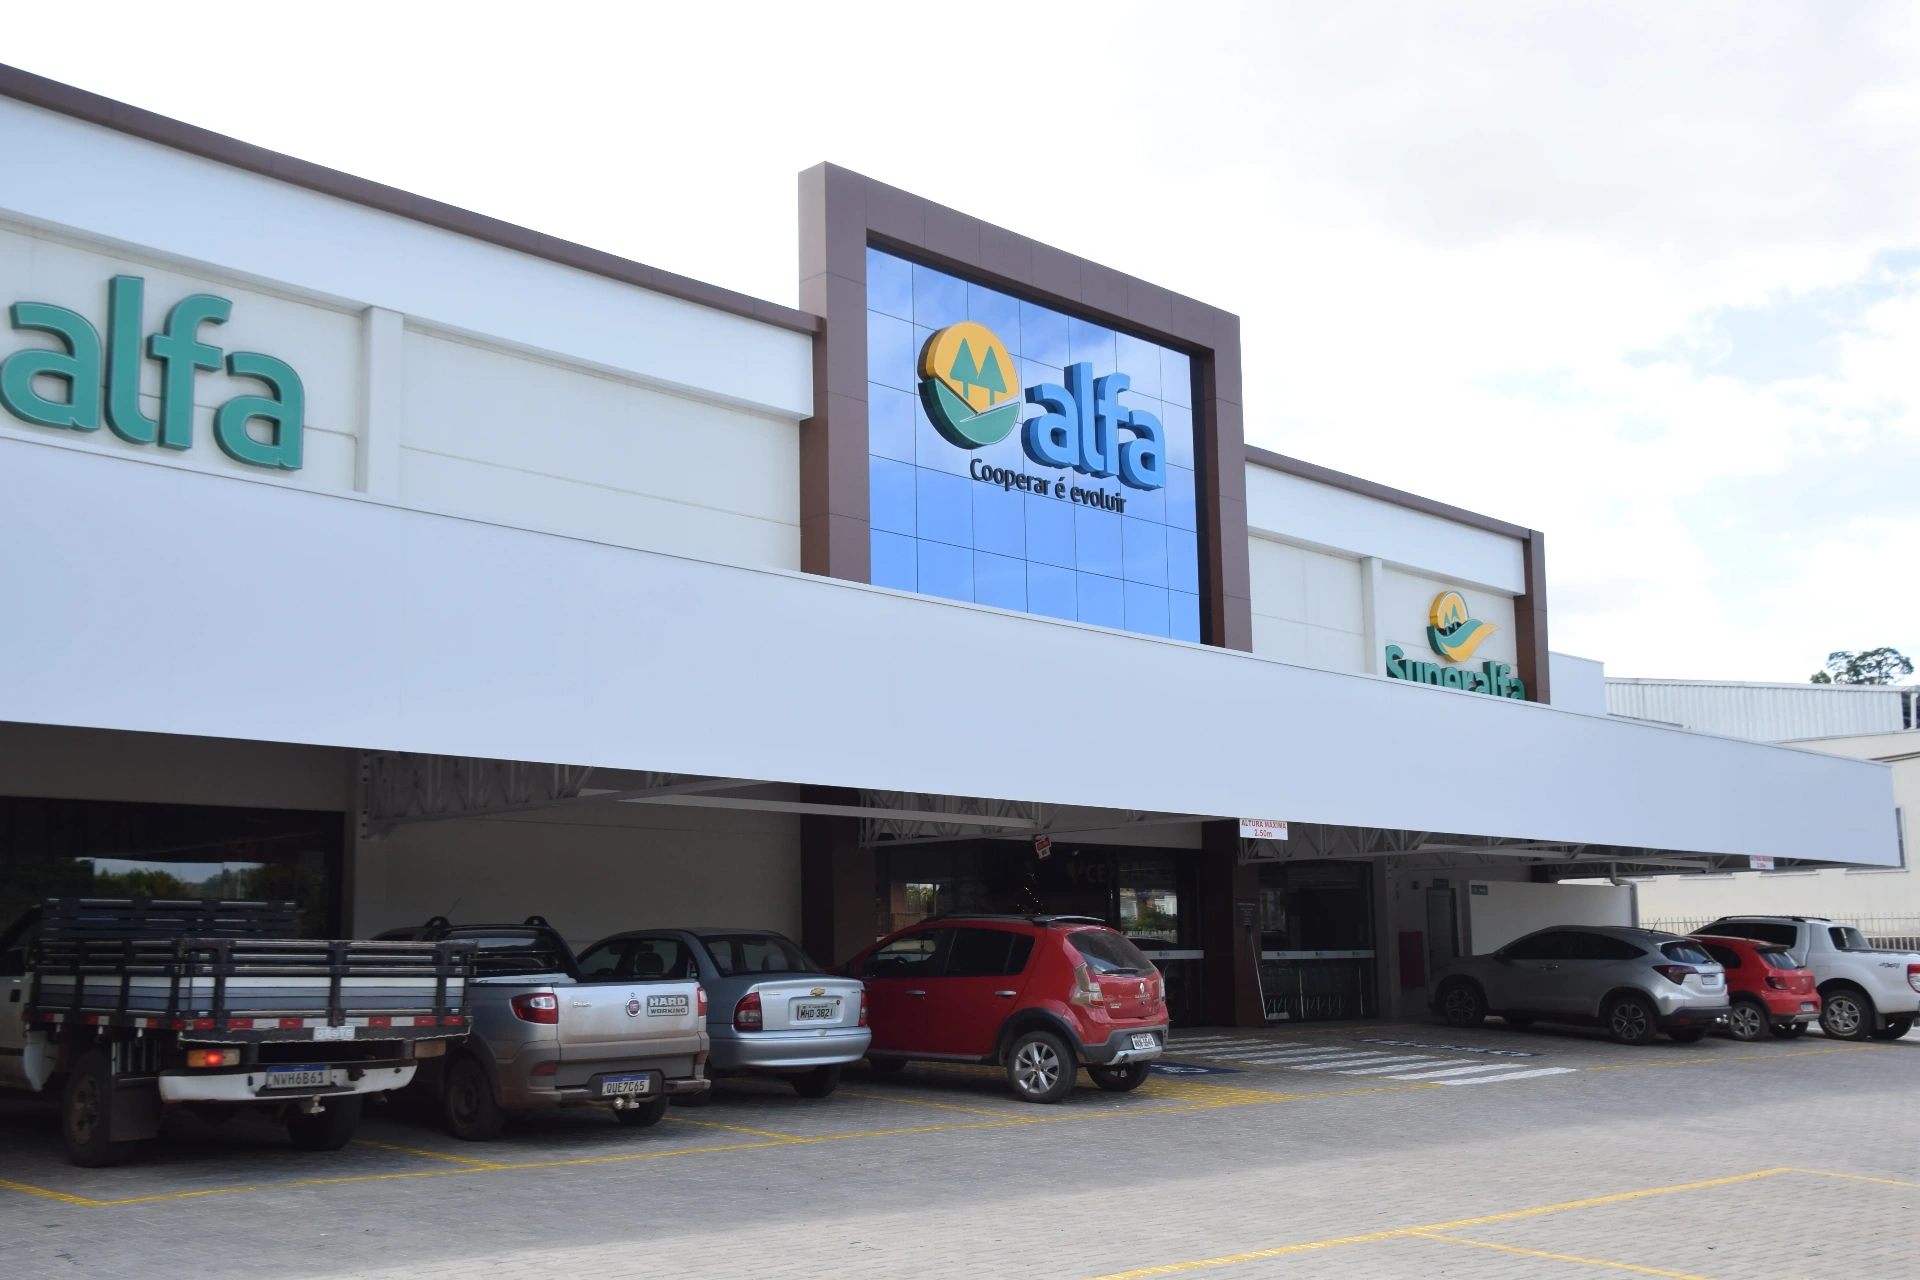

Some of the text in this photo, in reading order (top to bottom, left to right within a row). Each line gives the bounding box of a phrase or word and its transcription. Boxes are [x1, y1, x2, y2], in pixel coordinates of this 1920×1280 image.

[0, 274, 305, 471] alfa
[1021, 362, 1166, 491] alfa
[970, 458, 1127, 513] Cooperar é evoluir
[1241, 819, 1263, 828] ALTURA
[649, 997, 686, 1006] HARD
[606, 1081, 645, 1093] QUE7C65
